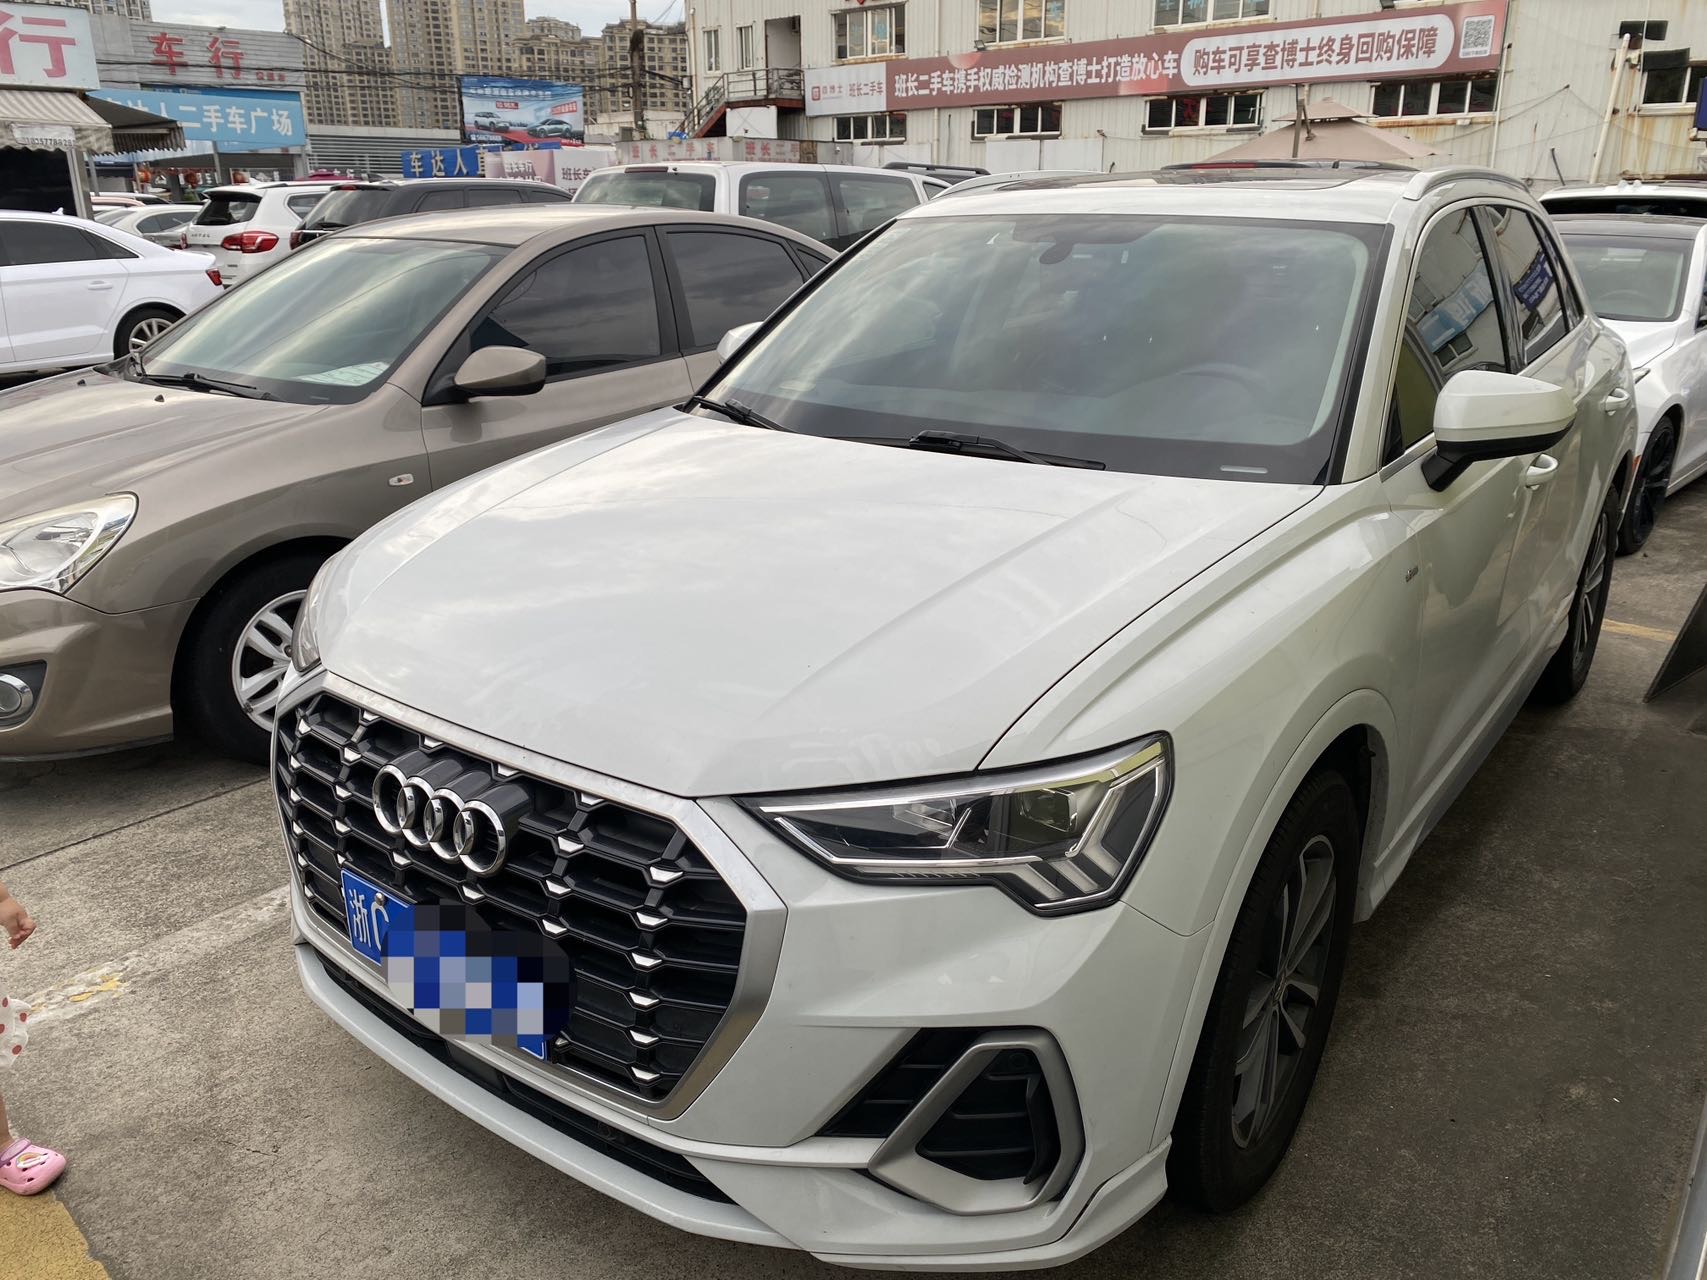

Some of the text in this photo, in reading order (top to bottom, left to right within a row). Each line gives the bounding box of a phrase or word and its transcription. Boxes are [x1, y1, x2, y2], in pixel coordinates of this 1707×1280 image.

[0, 10, 76, 78] 行
[148, 32, 246, 79] 车行
[1192, 26, 1440, 76] 购车可享查博士终身回购保障
[894, 50, 1180, 98] 班长二手车携手权威检测机构查博士打造放心车
